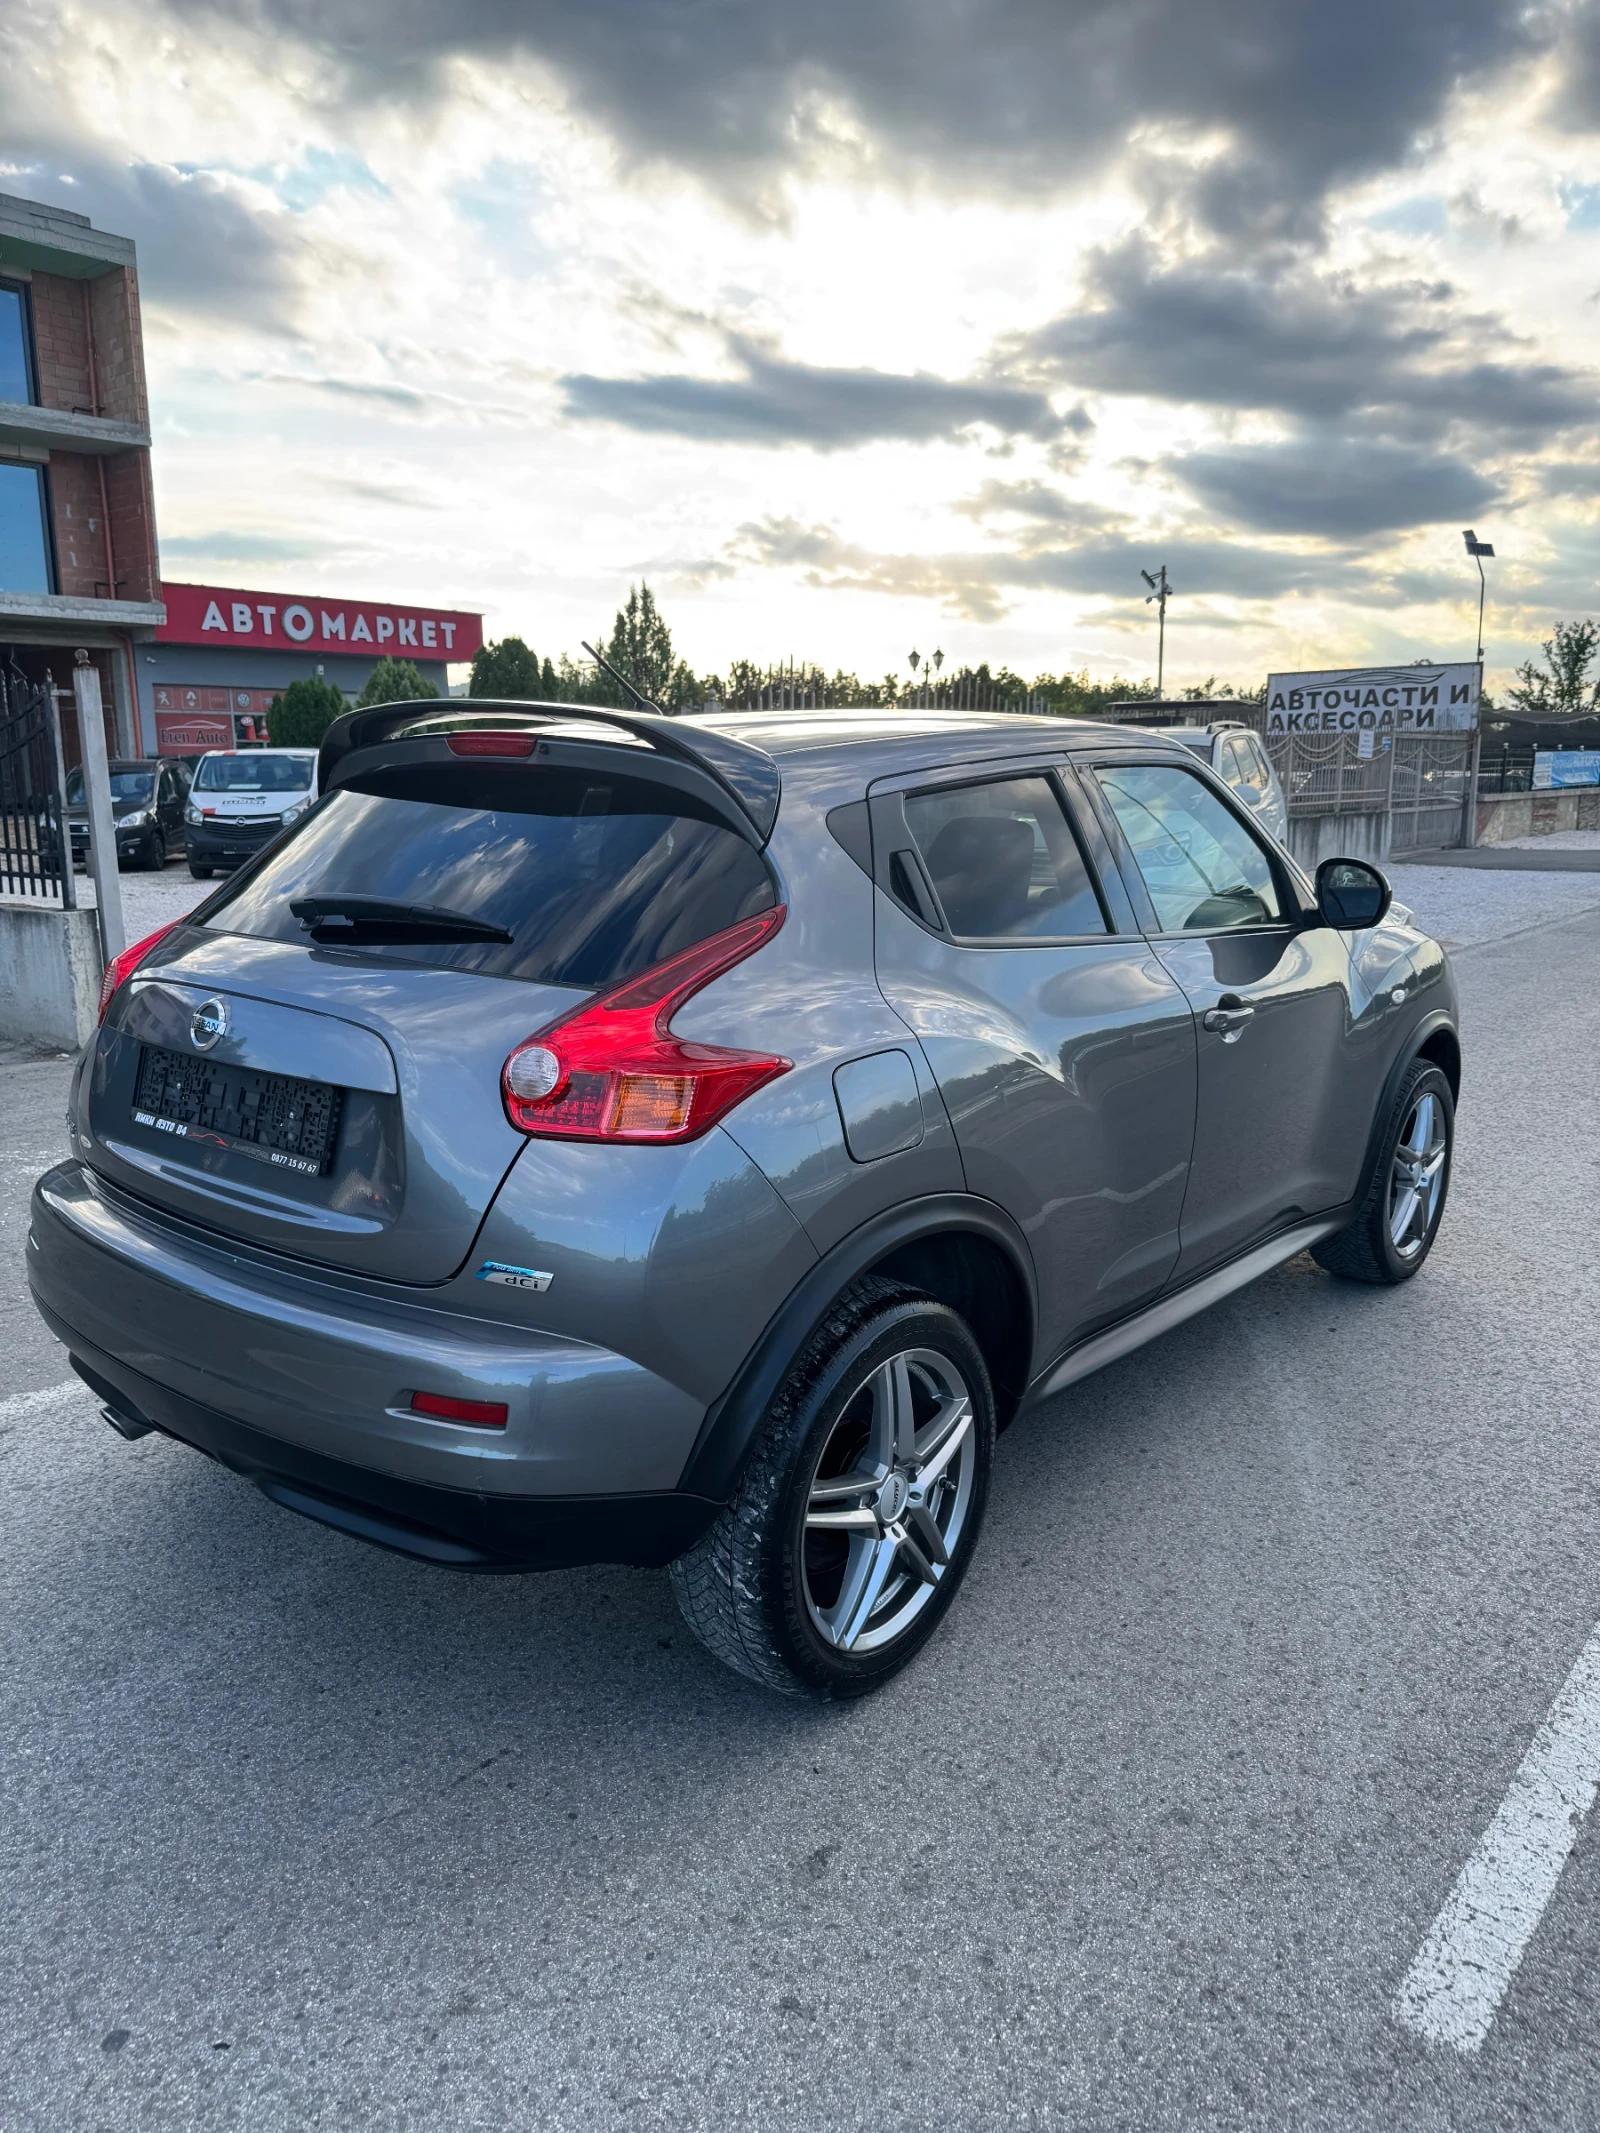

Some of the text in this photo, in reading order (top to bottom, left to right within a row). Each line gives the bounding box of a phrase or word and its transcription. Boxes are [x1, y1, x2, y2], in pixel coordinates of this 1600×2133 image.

[201, 600, 456, 649] АВТОМАРКЕТ
[1269, 684, 1470, 711] АВТОЧАСТИ И
[1268, 708, 1435, 732] АКСЕСОАРИ
[160, 729, 228, 744] Eren Auto
[271, 1153, 317, 1173] 0877 15 67 67
[504, 1276, 538, 1289] dCi
